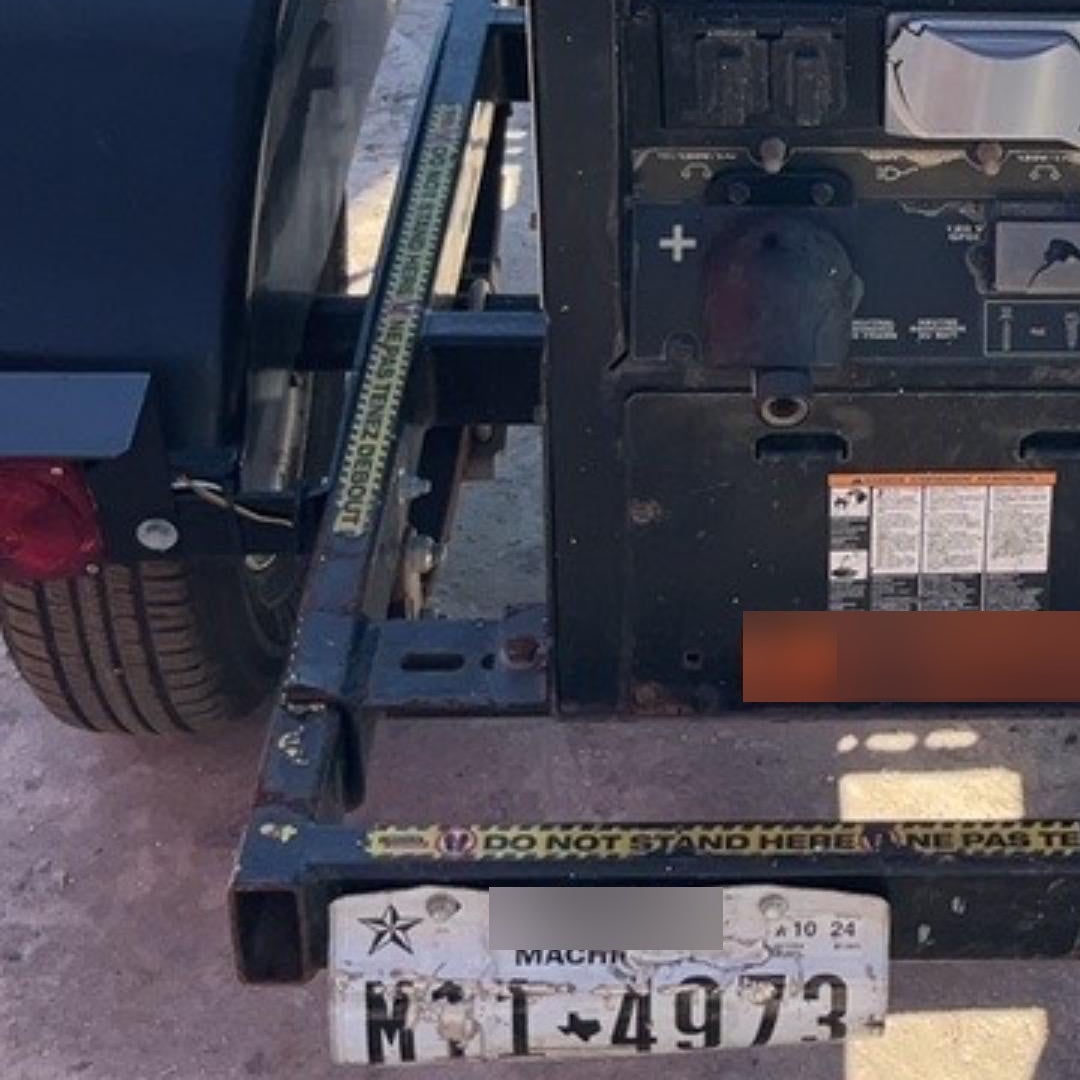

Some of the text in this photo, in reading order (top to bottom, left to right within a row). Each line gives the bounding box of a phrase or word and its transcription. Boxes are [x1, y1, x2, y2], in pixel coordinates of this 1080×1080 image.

[483, 831, 535, 852] DO
[549, 831, 624, 852] NOT
[629, 832, 750, 852] STAND
[759, 832, 858, 851] HERE
[904, 832, 952, 849] NE
[962, 831, 1031, 849] PAS
[793, 920, 857, 938] 10 24
[610, 973, 848, 1053] 4973
